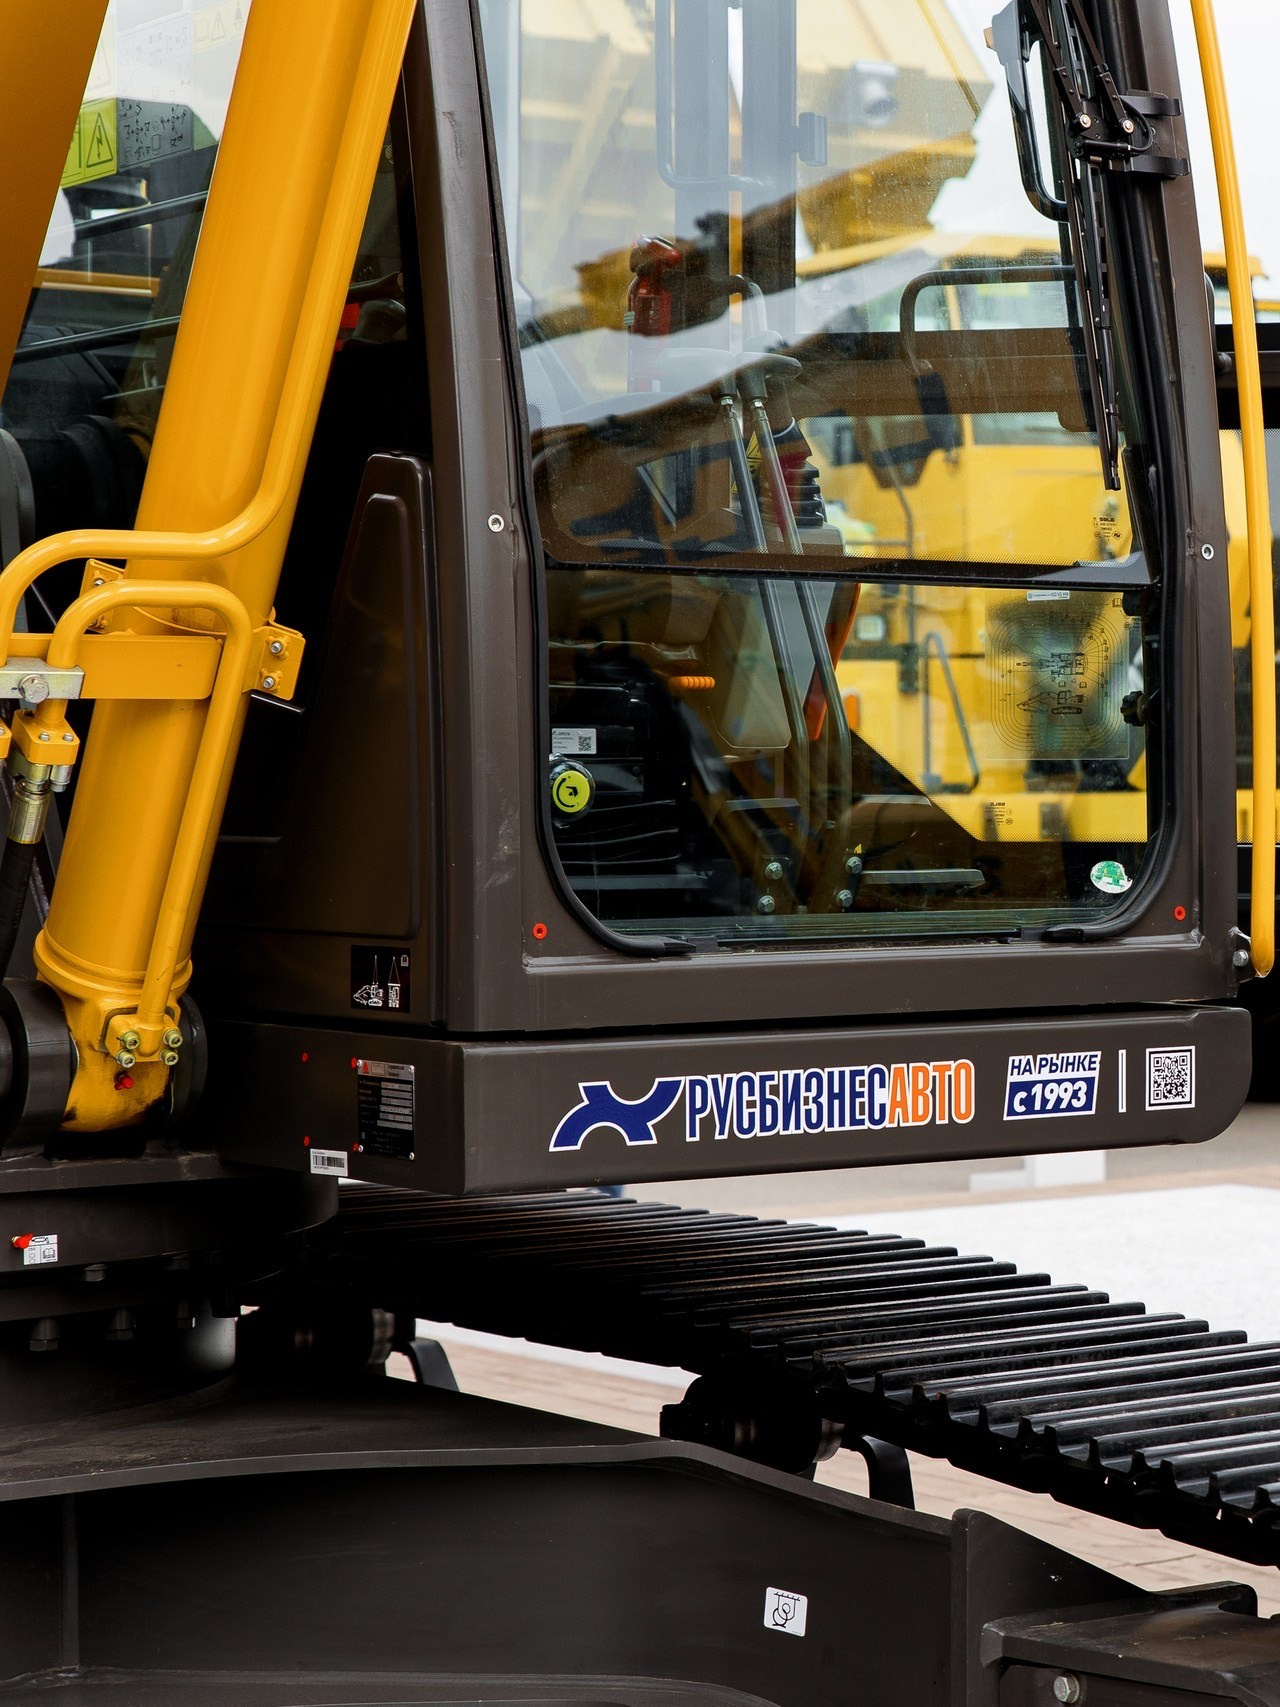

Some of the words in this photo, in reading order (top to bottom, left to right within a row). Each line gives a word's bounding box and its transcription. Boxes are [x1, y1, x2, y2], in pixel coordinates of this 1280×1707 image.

[1010, 1058, 1033, 1076] НА
[1038, 1054, 1099, 1075] РЫНКЕ
[686, 1060, 975, 1141] РУСБИЗНЕСАВТО
[1013, 1091, 1028, 1113] с
[1031, 1080, 1088, 1111] 1993
